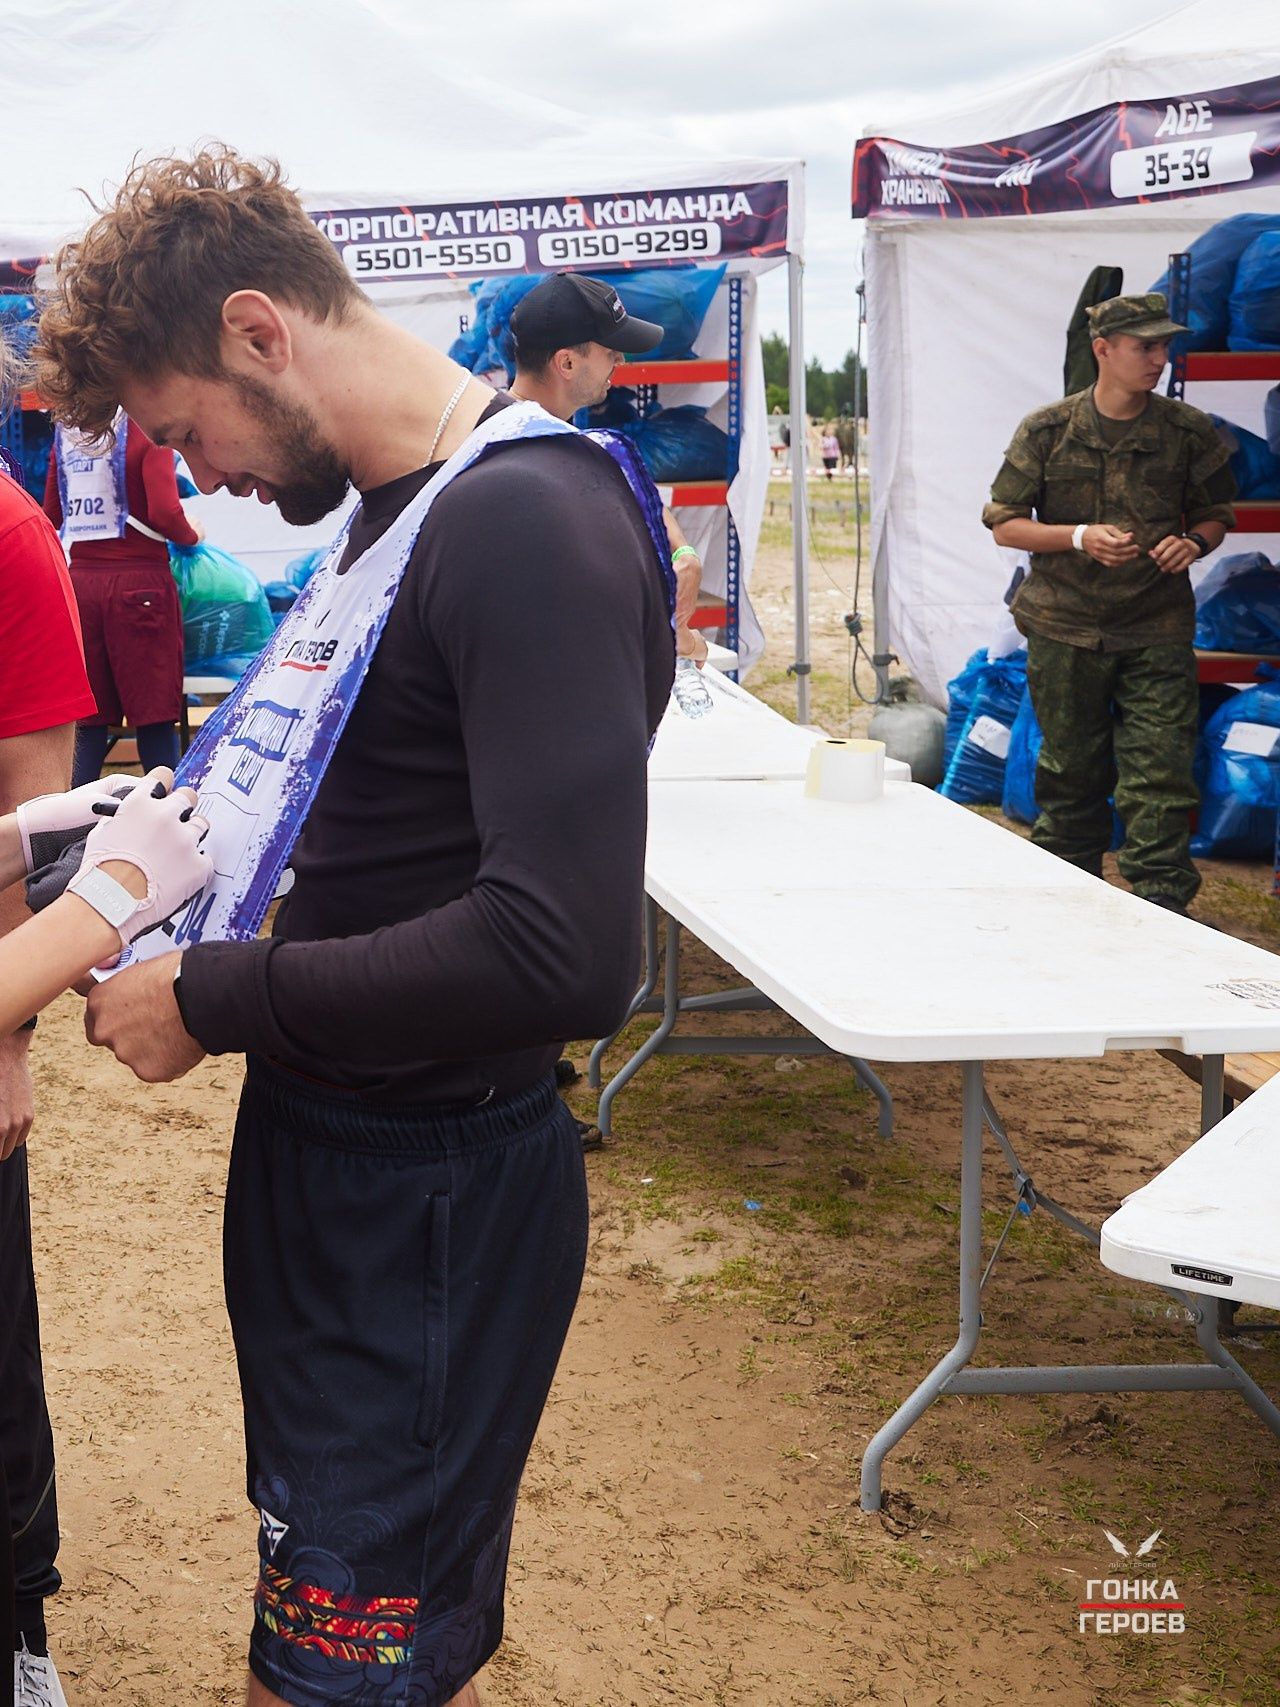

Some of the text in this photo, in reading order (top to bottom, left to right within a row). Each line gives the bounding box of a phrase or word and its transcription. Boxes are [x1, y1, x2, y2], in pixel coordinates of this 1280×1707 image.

[1154, 100, 1213, 137] AGE
[1145, 146, 1213, 186] 35-39
[594, 191, 753, 225] КОМАНДА
[881, 178, 951, 206] ХРАНЕНИЯ
[356, 227, 709, 271] 5501-5550 9150-9299
[1179, 1267, 1225, 1283] LIFETIME
